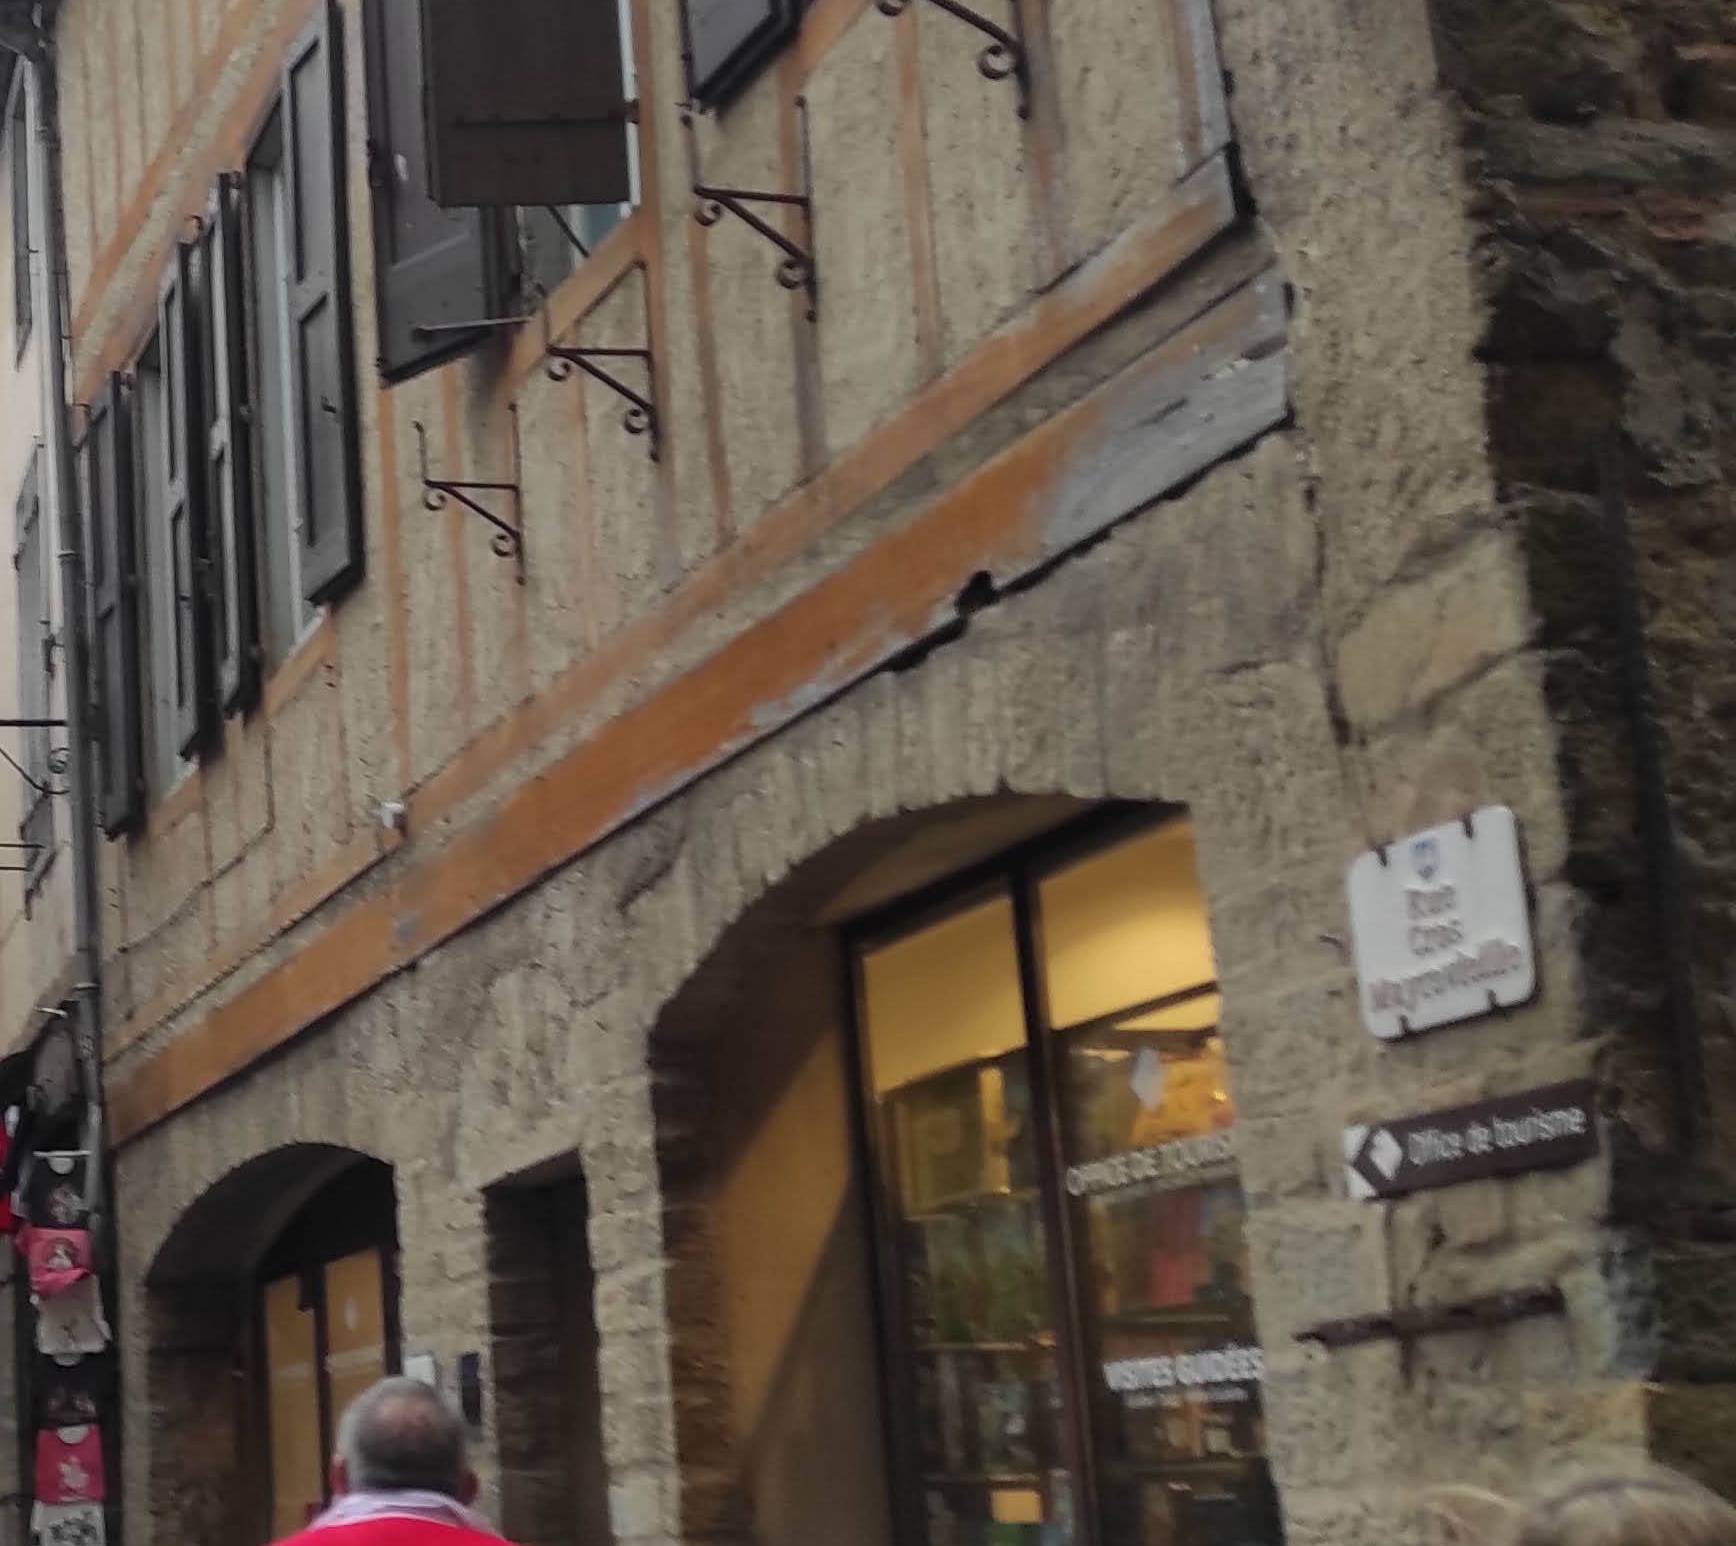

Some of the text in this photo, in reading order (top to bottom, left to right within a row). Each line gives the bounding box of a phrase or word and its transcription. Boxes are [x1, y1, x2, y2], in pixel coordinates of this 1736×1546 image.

[1408, 1107, 1586, 1165] Office de tourisme
[1103, 1355, 1175, 1390] VISITES
